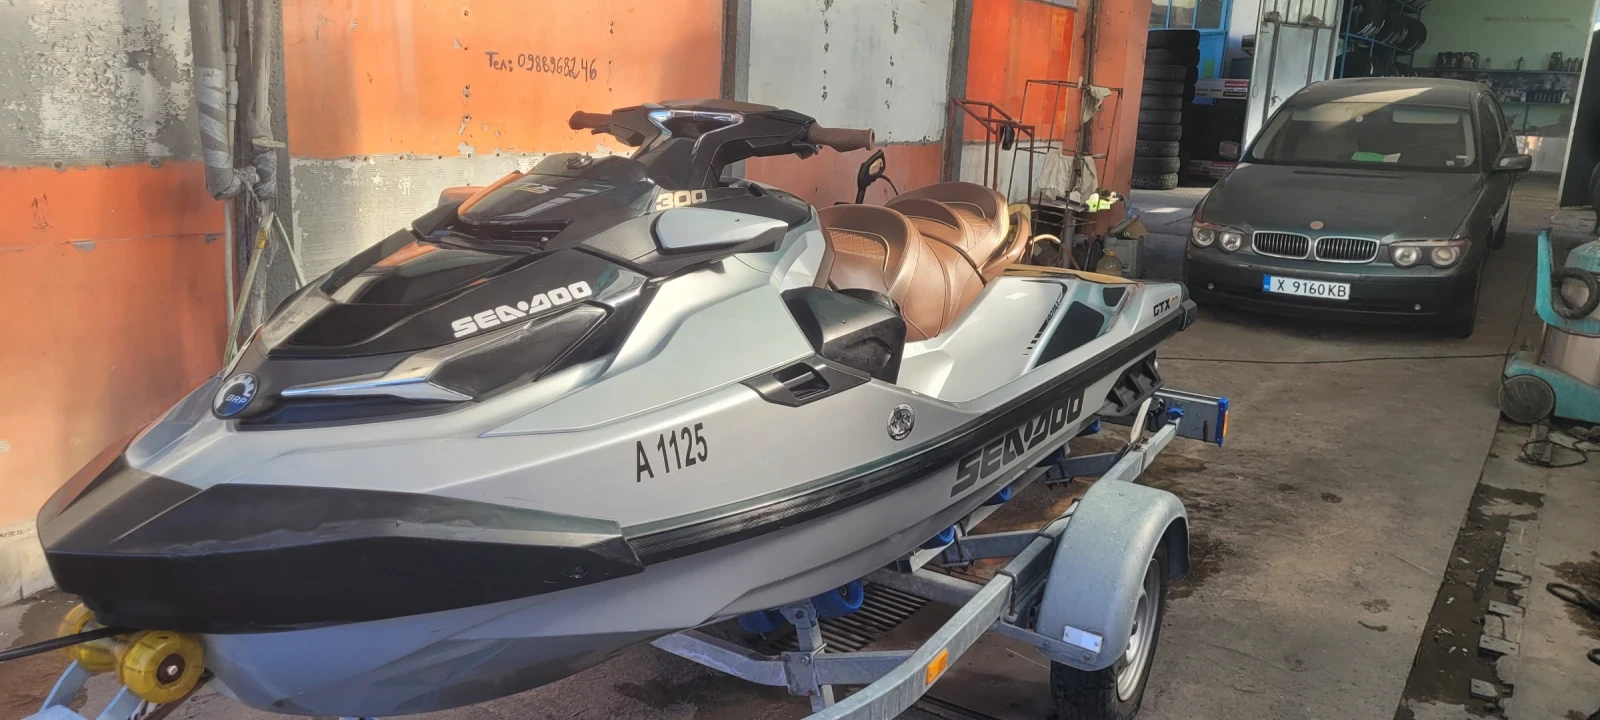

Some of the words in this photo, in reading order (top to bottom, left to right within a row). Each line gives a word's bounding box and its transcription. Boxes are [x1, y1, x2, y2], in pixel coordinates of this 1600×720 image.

[655, 189, 707, 211] 300
[1153, 298, 1170, 317] GTX
[225, 394, 248, 405] BRP
[636, 440, 655, 483] A
[657, 422, 708, 474] 1125
